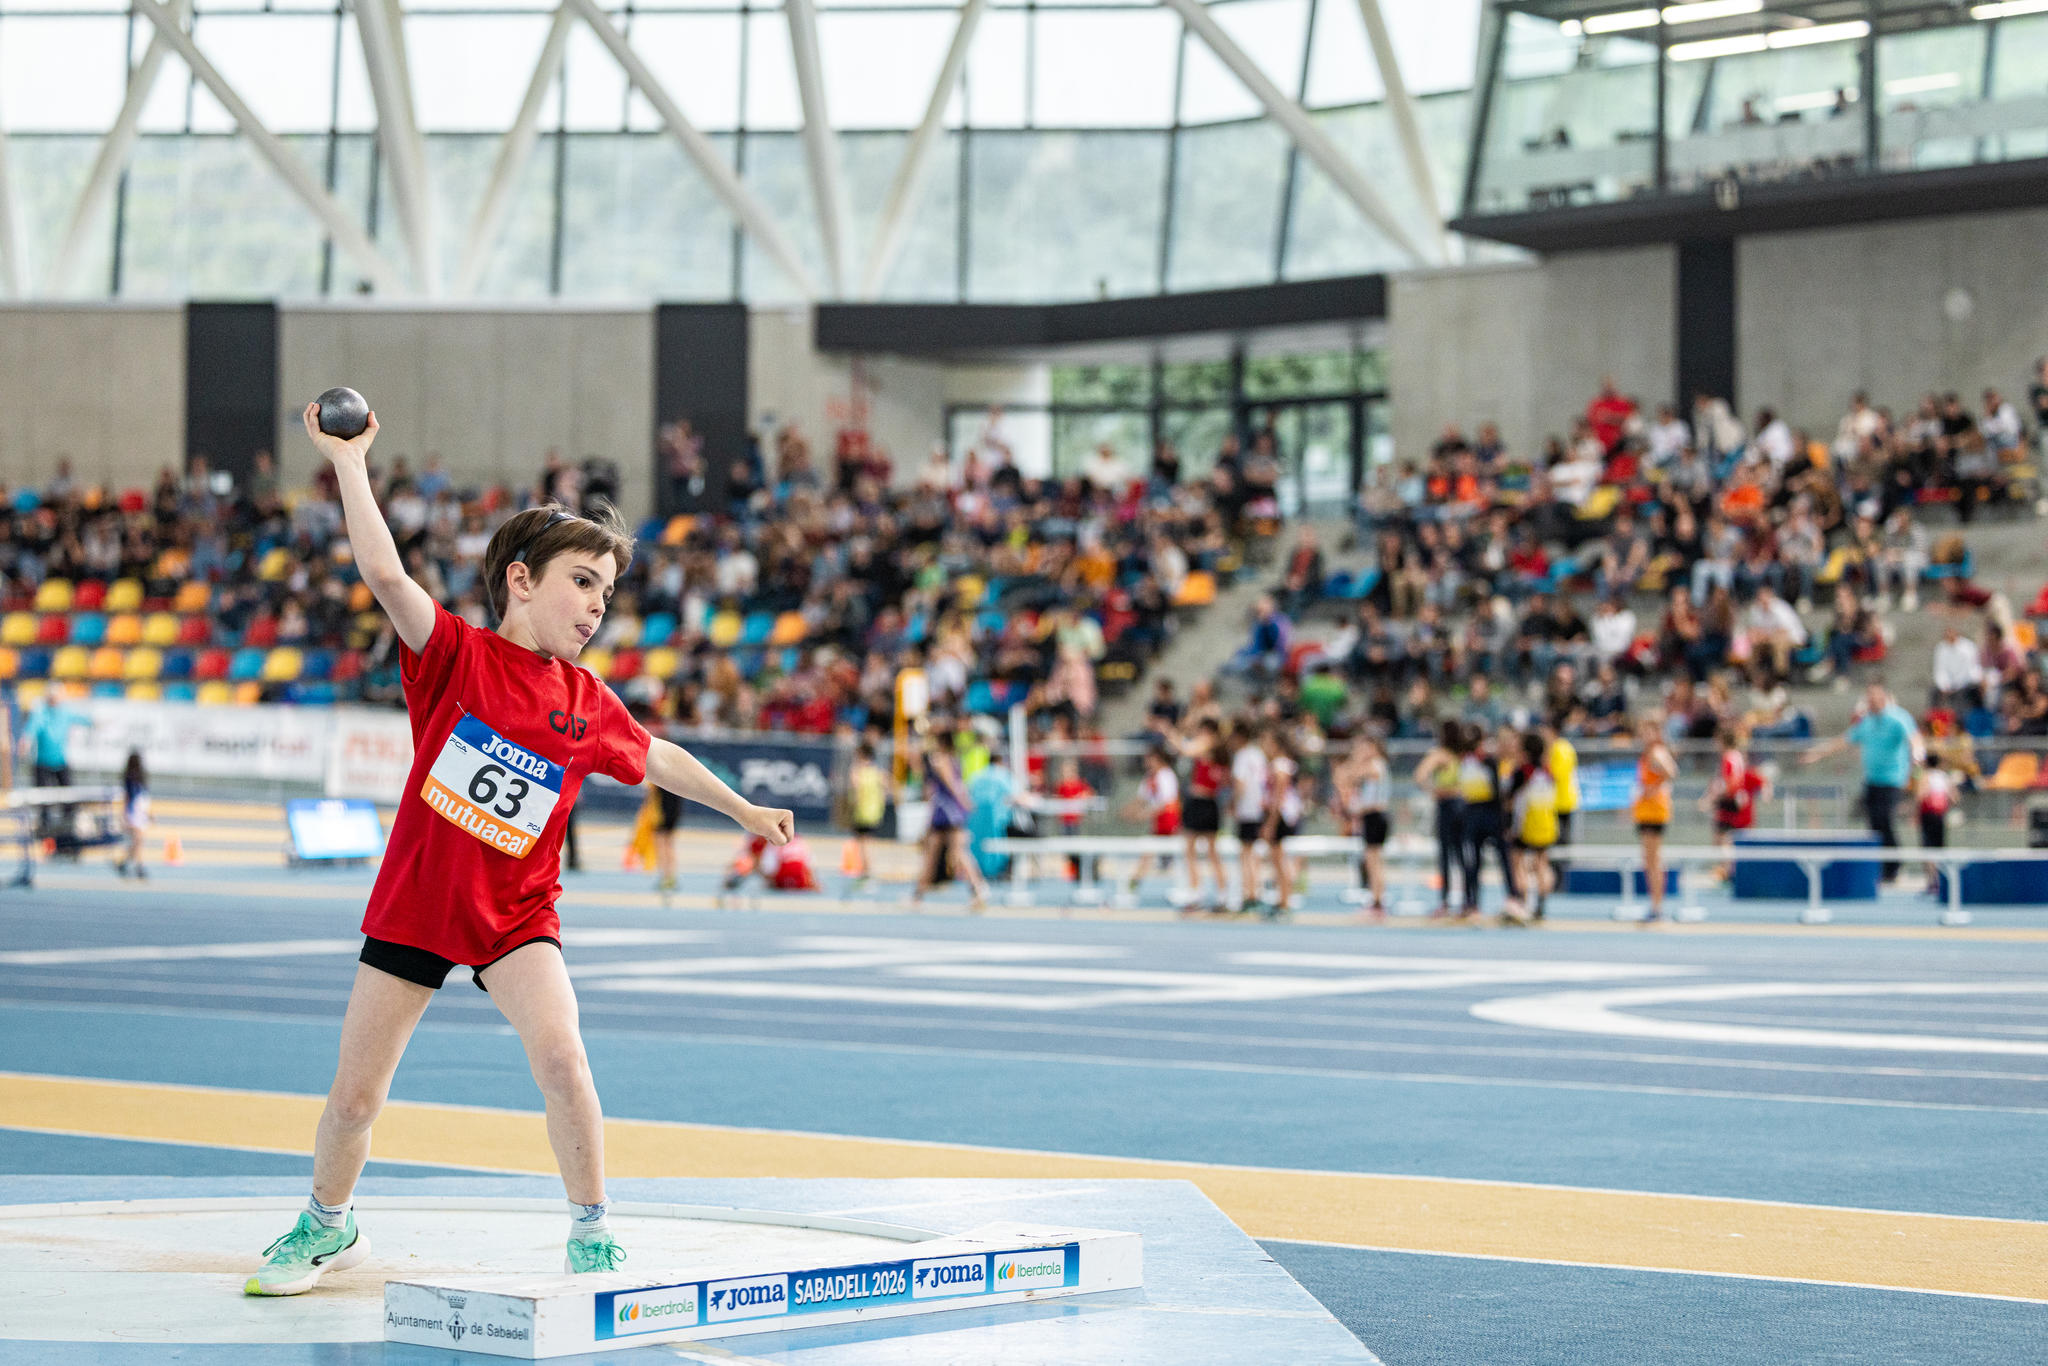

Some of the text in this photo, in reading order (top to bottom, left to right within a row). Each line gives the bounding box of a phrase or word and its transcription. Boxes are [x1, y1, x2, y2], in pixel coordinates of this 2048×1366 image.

[468, 764, 530, 819] 63
[427, 785, 529, 856] mutuacat
[1017, 1261, 1061, 1278] Iberdrola
[794, 1269, 906, 1305] SABADELL 2026
[642, 1297, 694, 1318] Iberdrola
[387, 1311, 529, 1341] Ajuntament de Sabadell
